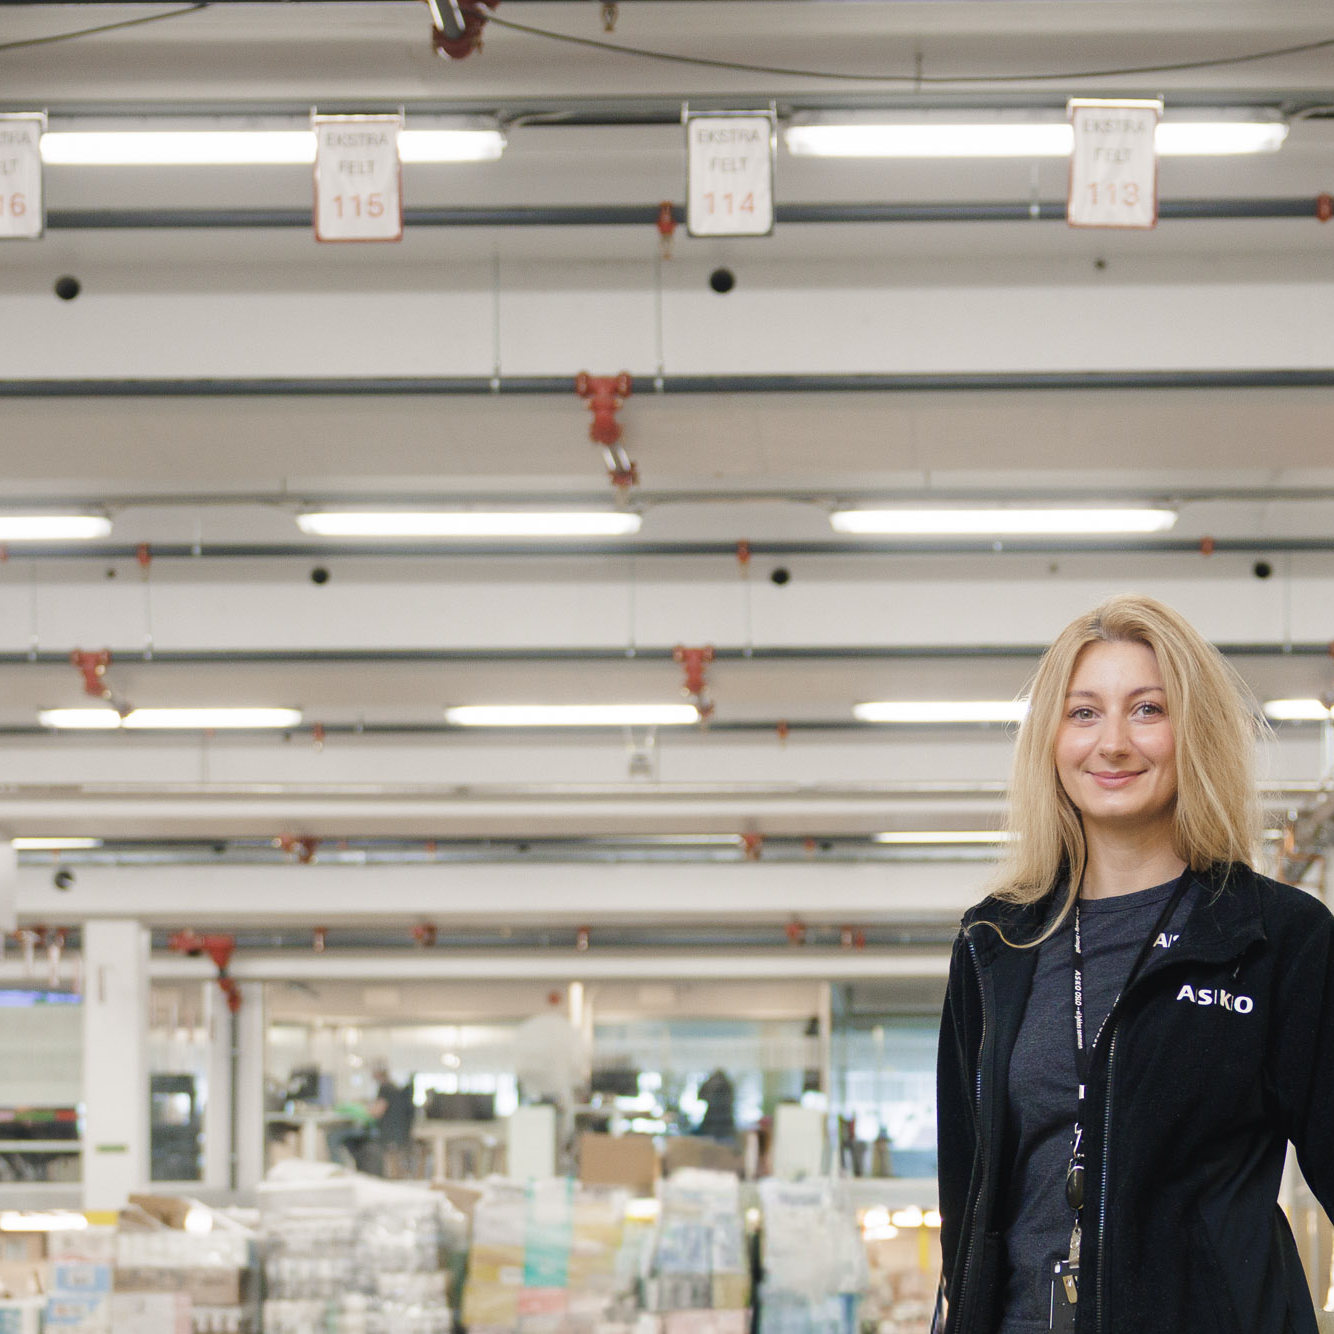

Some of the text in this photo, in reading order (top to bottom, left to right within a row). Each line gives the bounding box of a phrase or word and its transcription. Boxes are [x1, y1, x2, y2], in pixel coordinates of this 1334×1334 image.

[698, 128, 761, 144] EKSTRA
[333, 192, 385, 218] 115
[703, 191, 755, 215] 114
[1086, 181, 1140, 207] 113
[1176, 984, 1254, 1014] ASKO
